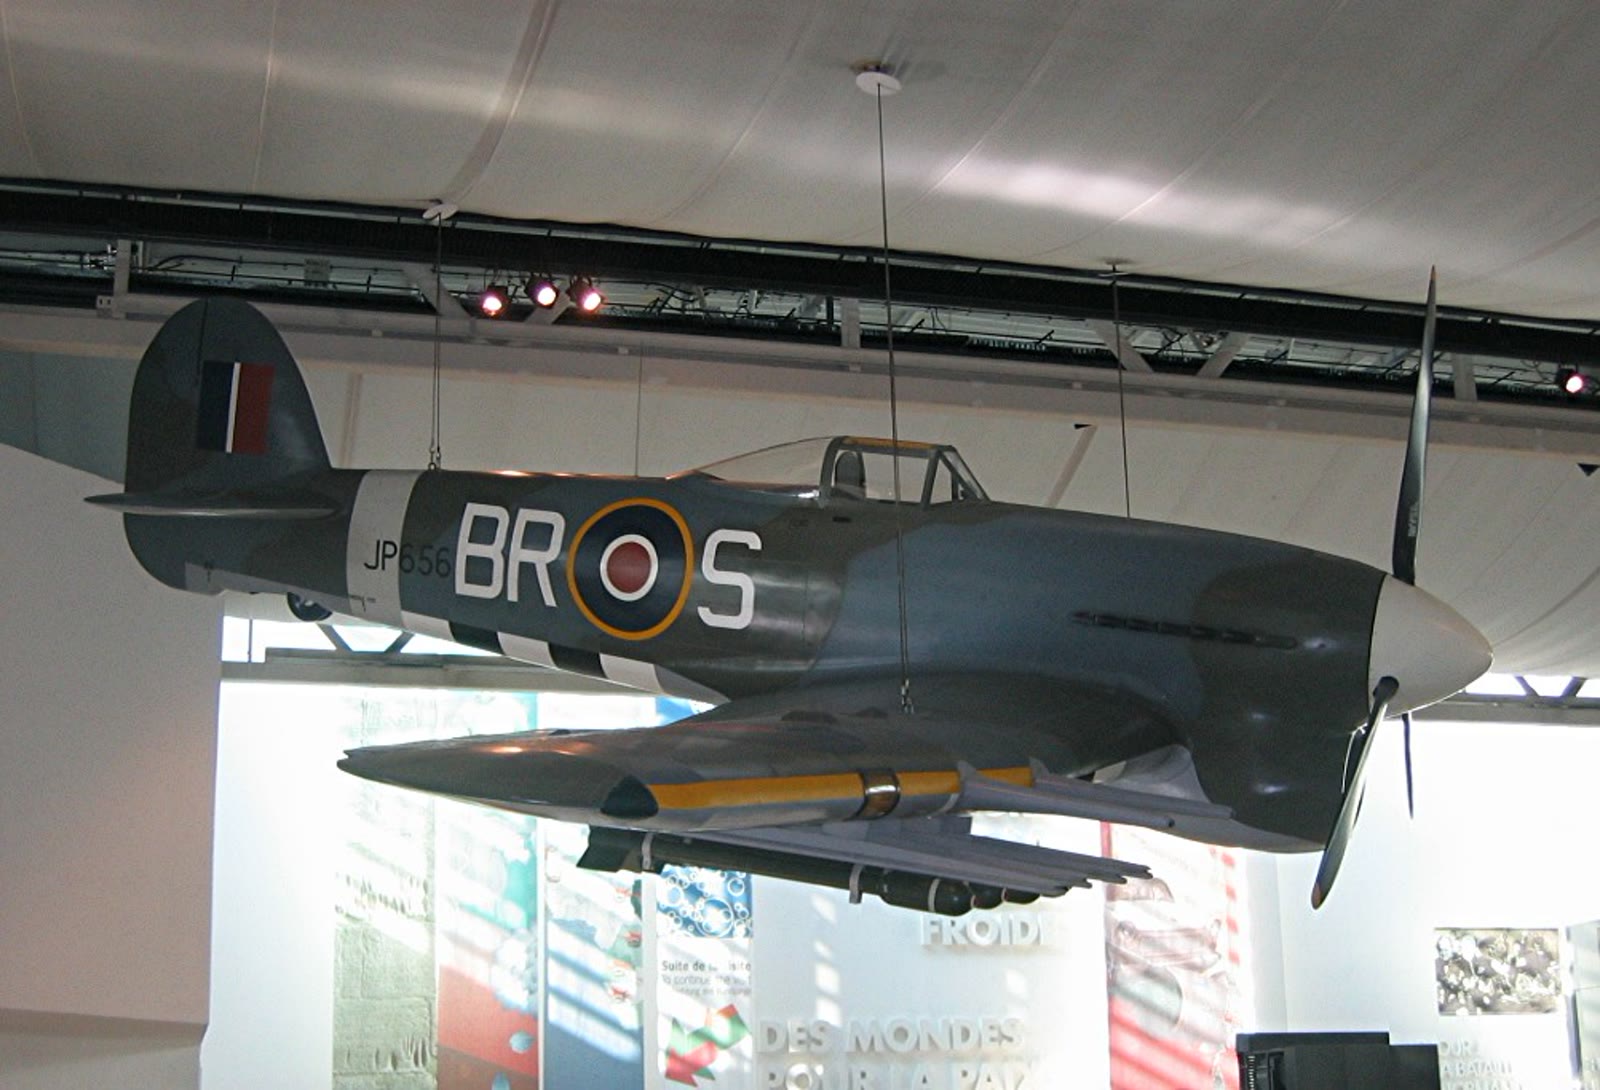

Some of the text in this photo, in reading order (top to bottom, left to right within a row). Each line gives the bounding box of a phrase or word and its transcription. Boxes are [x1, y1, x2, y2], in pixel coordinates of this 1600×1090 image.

[363, 538, 452, 579] JP656
[454, 502, 763, 630] BR S
[661, 960, 689, 972] Suite
[692, 960, 706, 972] de
[758, 1017, 1025, 1054] DES MONDES
